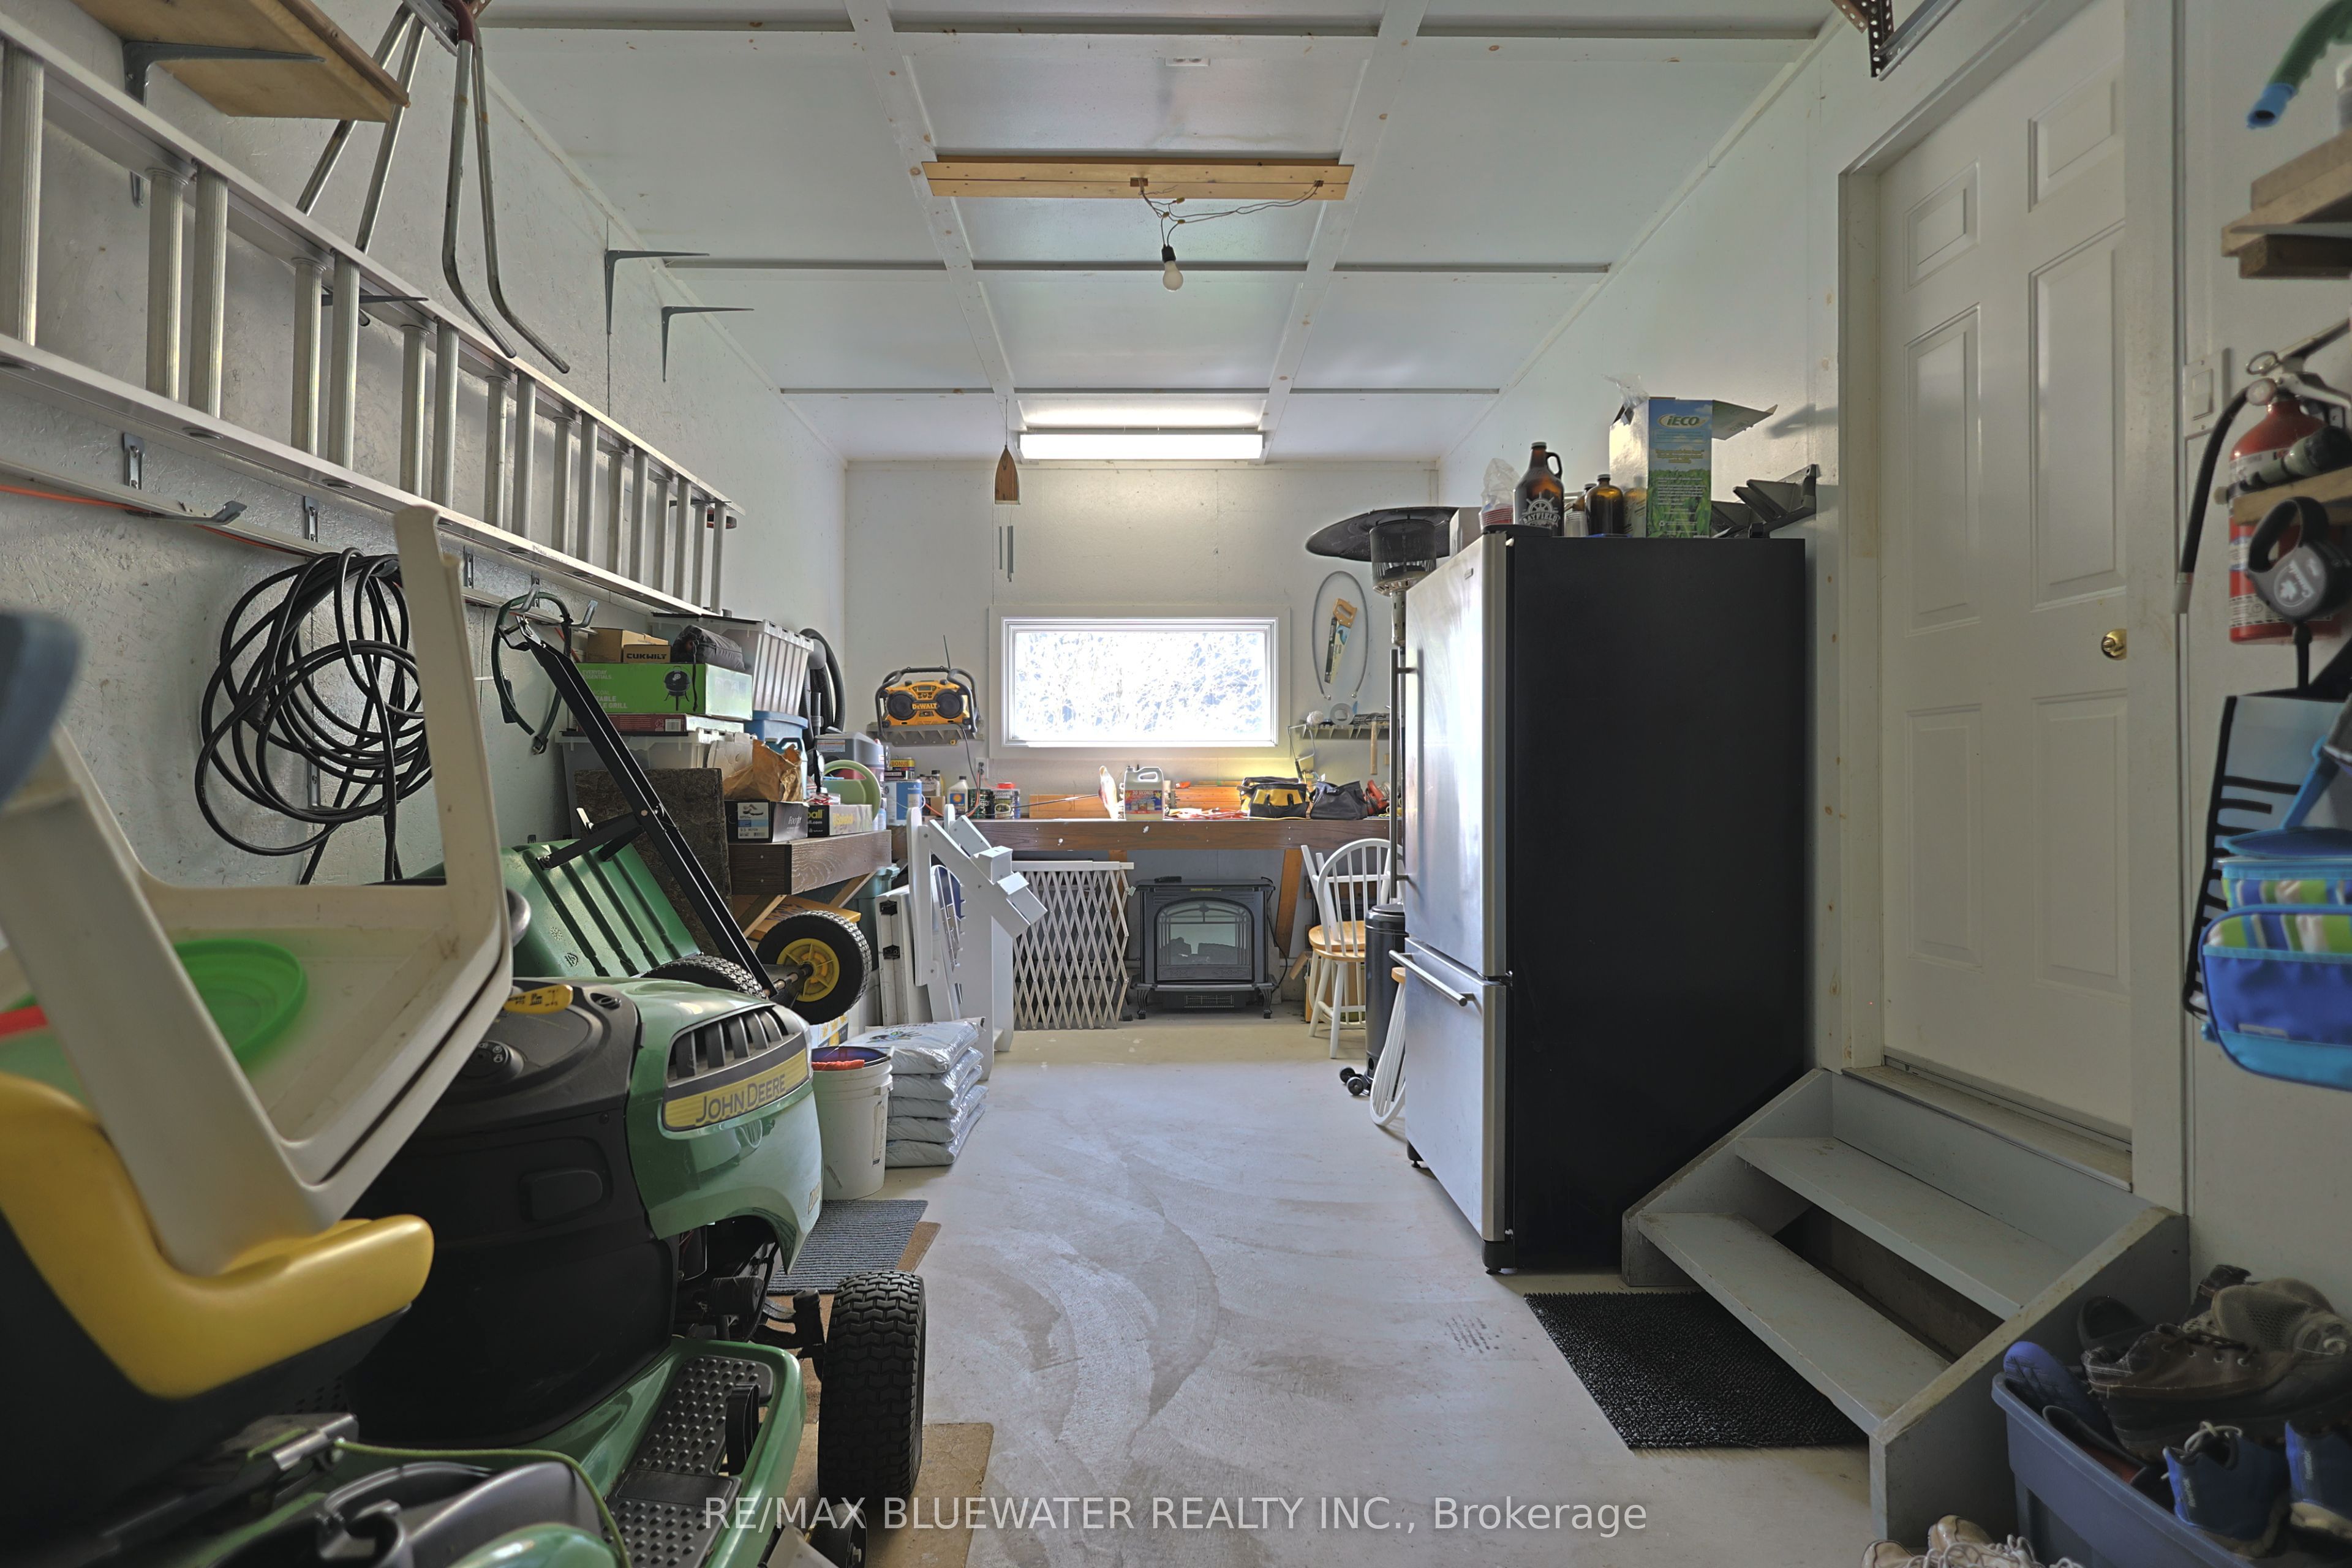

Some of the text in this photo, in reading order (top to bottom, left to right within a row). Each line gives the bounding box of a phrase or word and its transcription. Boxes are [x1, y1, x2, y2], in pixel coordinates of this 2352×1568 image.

[1667, 415, 1700, 426] iECO
[1523, 513, 1558, 524] BAYFIELD
[695, 1074, 785, 1123] JOHN DEERE
